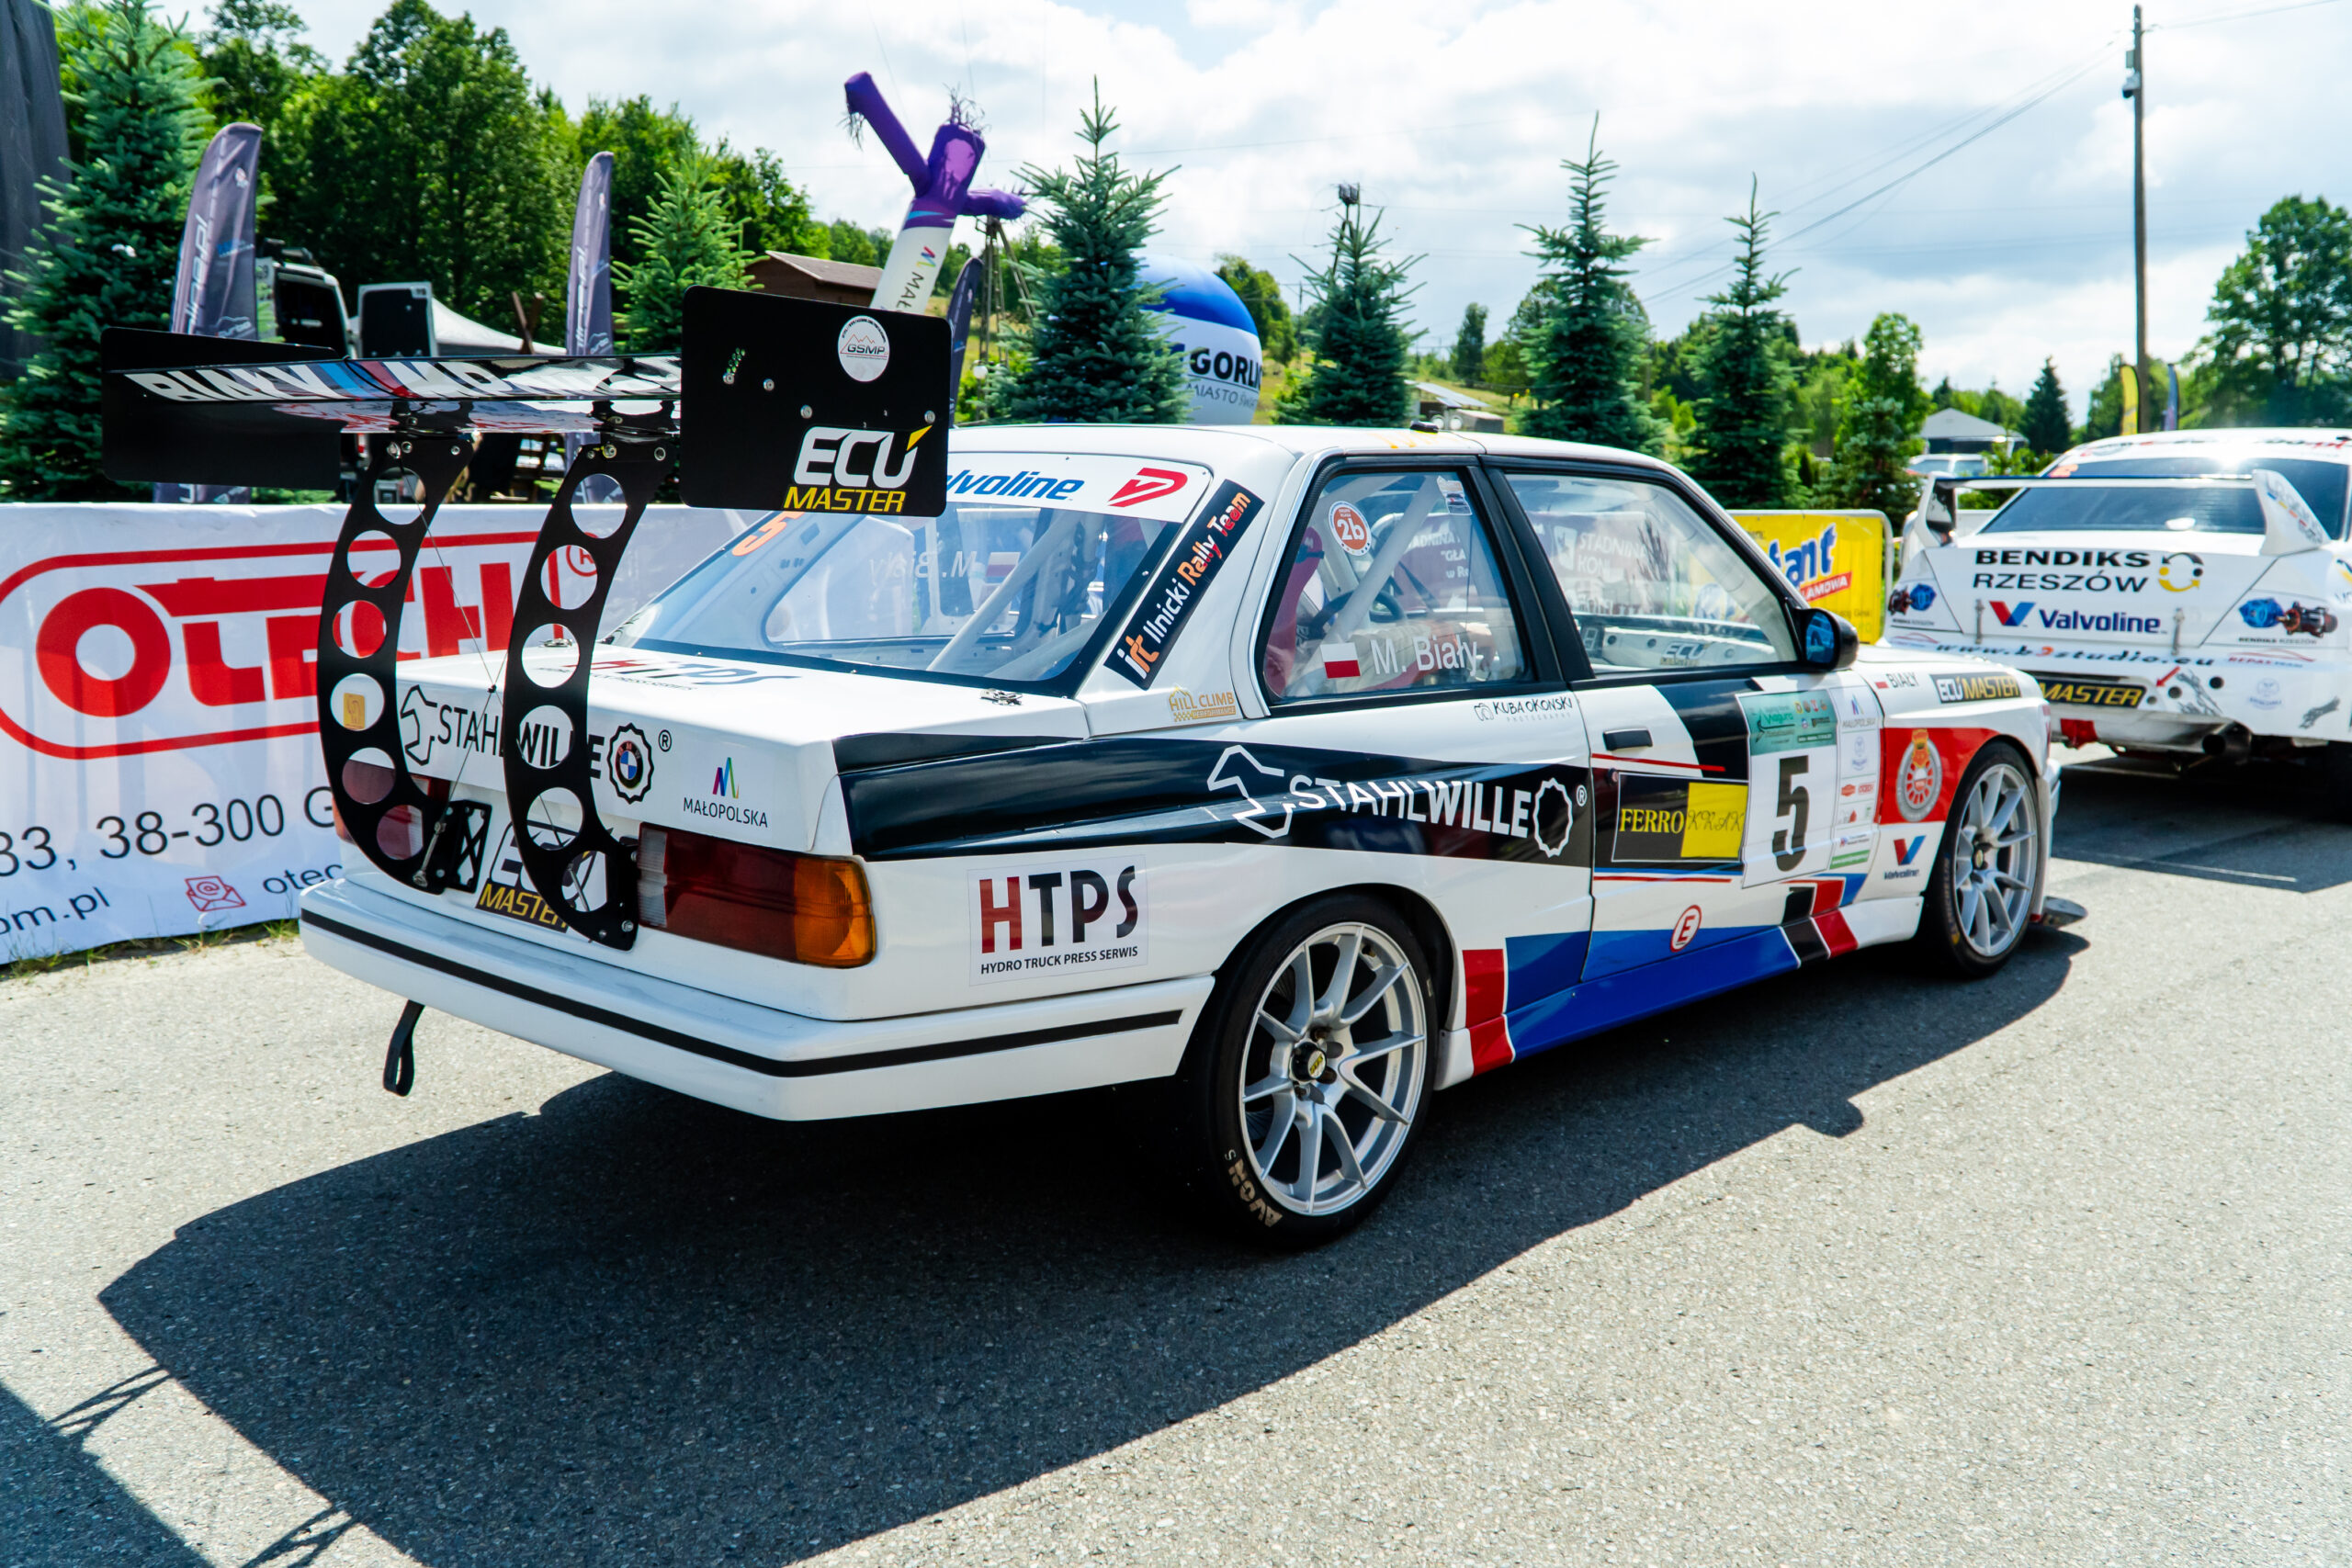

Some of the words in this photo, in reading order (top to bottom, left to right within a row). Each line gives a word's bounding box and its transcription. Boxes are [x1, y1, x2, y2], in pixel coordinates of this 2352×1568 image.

[897, 271, 924, 313] MAŁ
[847, 344, 886, 355] GSMP
[784, 486, 906, 513] MASTER
[947, 469, 1085, 501] lvoline
[1178, 541, 1223, 586] Rally
[1207, 491, 1252, 536] Team
[1337, 518, 1365, 540] 2b
[1975, 549, 2152, 568] BENDIKS
[1973, 569, 2149, 593] RZESZÓW
[2039, 608, 2162, 634] Valvoline
[1370, 638, 1407, 675] M.
[1414, 634, 1477, 677] Biały
[1199, 692, 1236, 707] CLIMB
[1492, 701, 1525, 715] KUBA
[683, 795, 769, 828] MAŁOPOLSKA
[1289, 774, 1532, 840] STAHLWILLE
[1772, 755, 1809, 872] 5
[96, 794, 285, 859] 38-300
[978, 864, 1139, 954] HTPS
[980, 959, 1023, 975] HYDRO
[1024, 955, 1061, 970] TRUCK
[1064, 950, 1097, 965] PRESS
[1099, 946, 1138, 961] SERWIS
[1228, 1157, 1283, 1228] AVON
